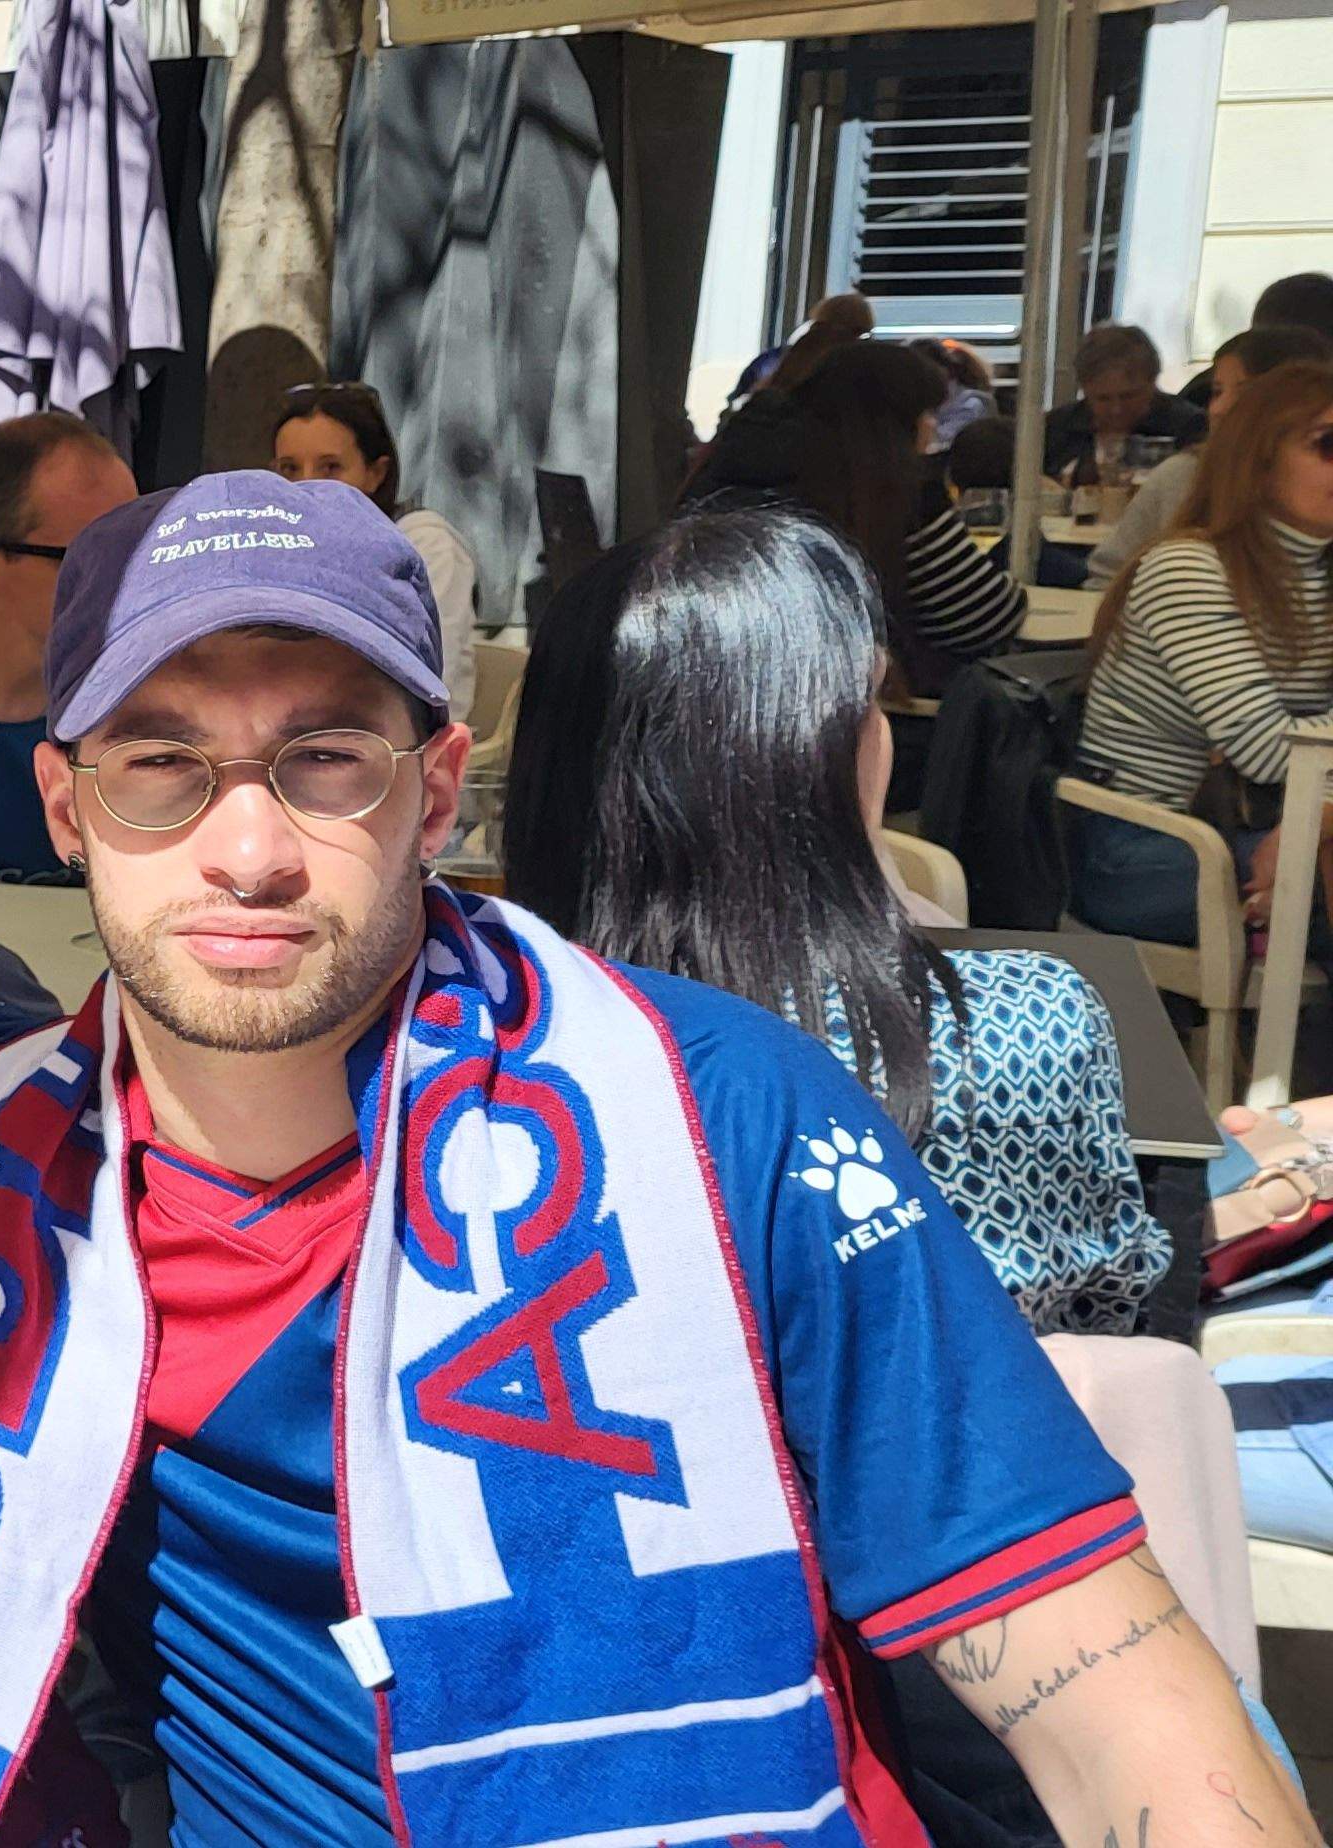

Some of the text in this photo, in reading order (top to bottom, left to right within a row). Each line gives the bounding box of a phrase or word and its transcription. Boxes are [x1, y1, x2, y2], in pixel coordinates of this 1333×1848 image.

[157, 504, 303, 539] for everyday
[148, 531, 315, 564] TRAVELLERS
[831, 1196, 929, 1265] KELME
